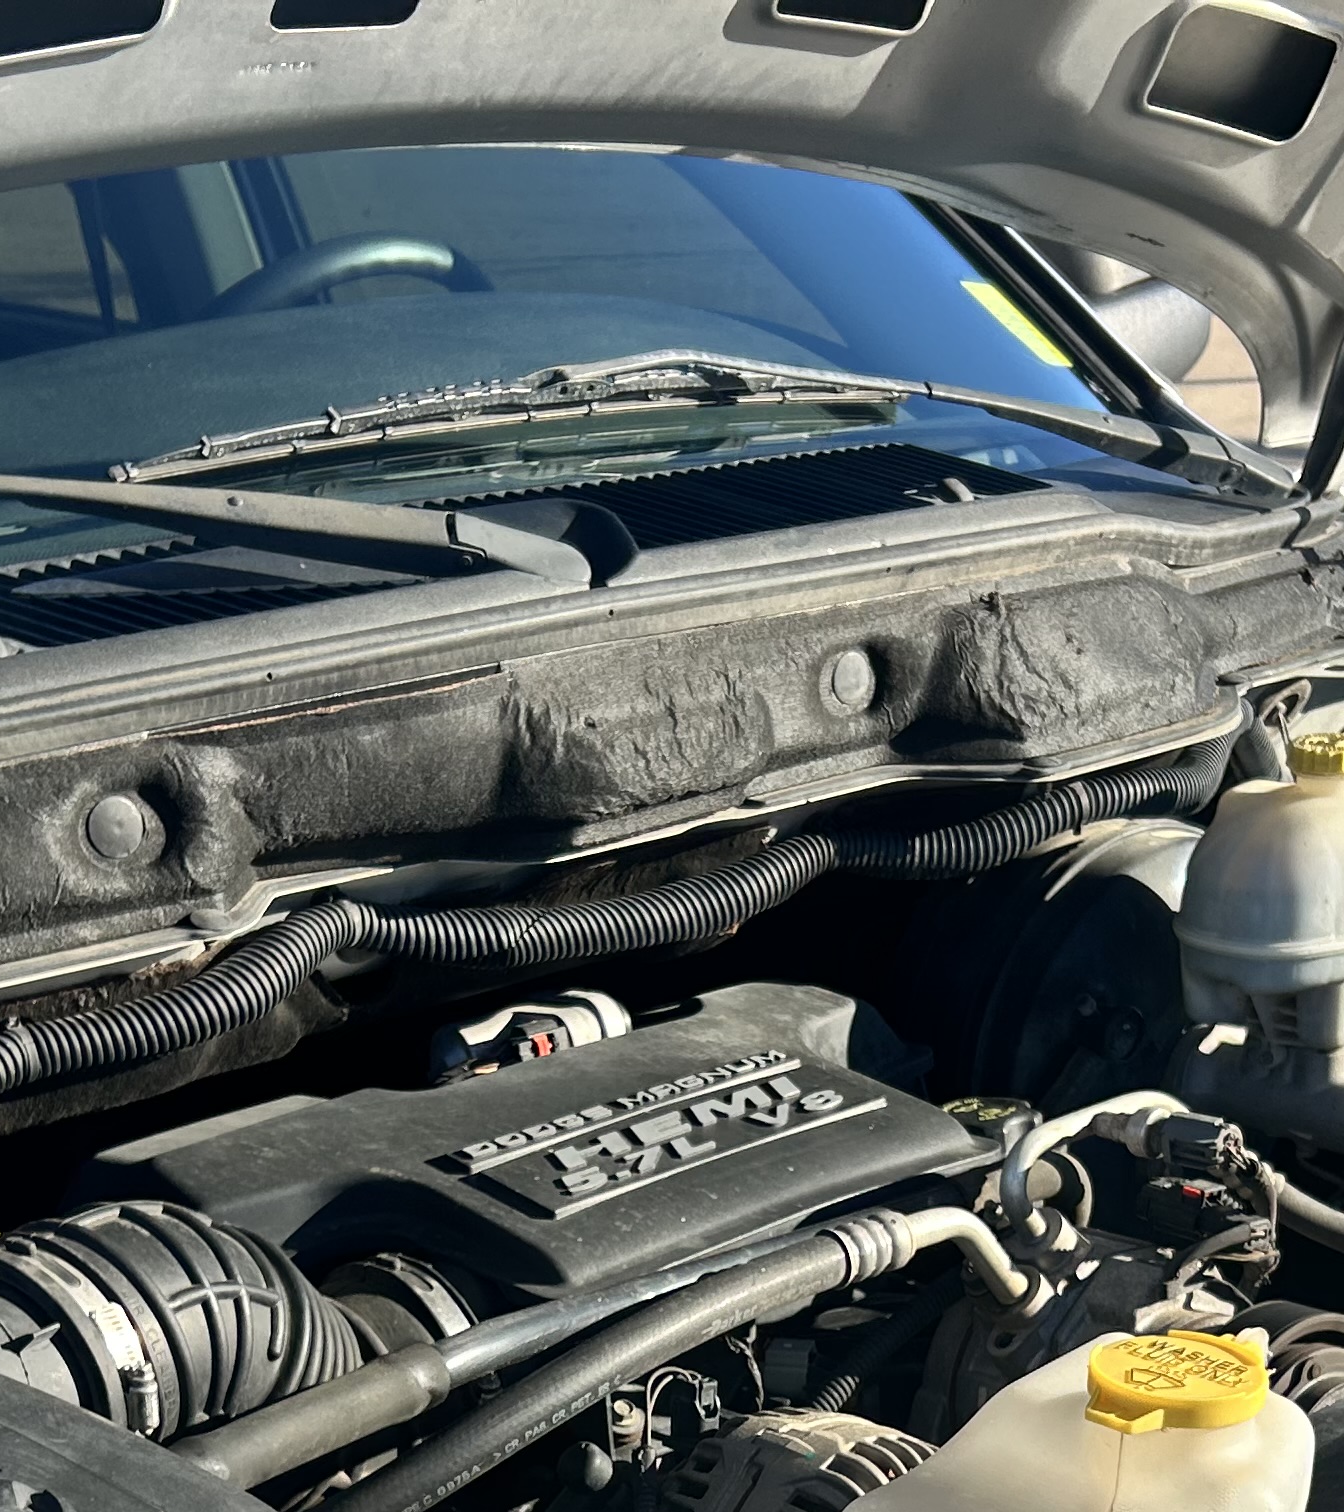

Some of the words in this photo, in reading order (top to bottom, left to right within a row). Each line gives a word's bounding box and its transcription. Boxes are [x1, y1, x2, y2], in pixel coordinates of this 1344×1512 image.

[460, 1104, 619, 1160] DODGE
[616, 1048, 790, 1111] MAGNUM
[545, 1075, 804, 1173] HEMI
[556, 1139, 718, 1196] 5.7L
[747, 1087, 847, 1131] V8
[1114, 1341, 1182, 1367] FLUID
[1184, 1363, 1250, 1388] ONLY
[1150, 1339, 1250, 1376] WASHER
